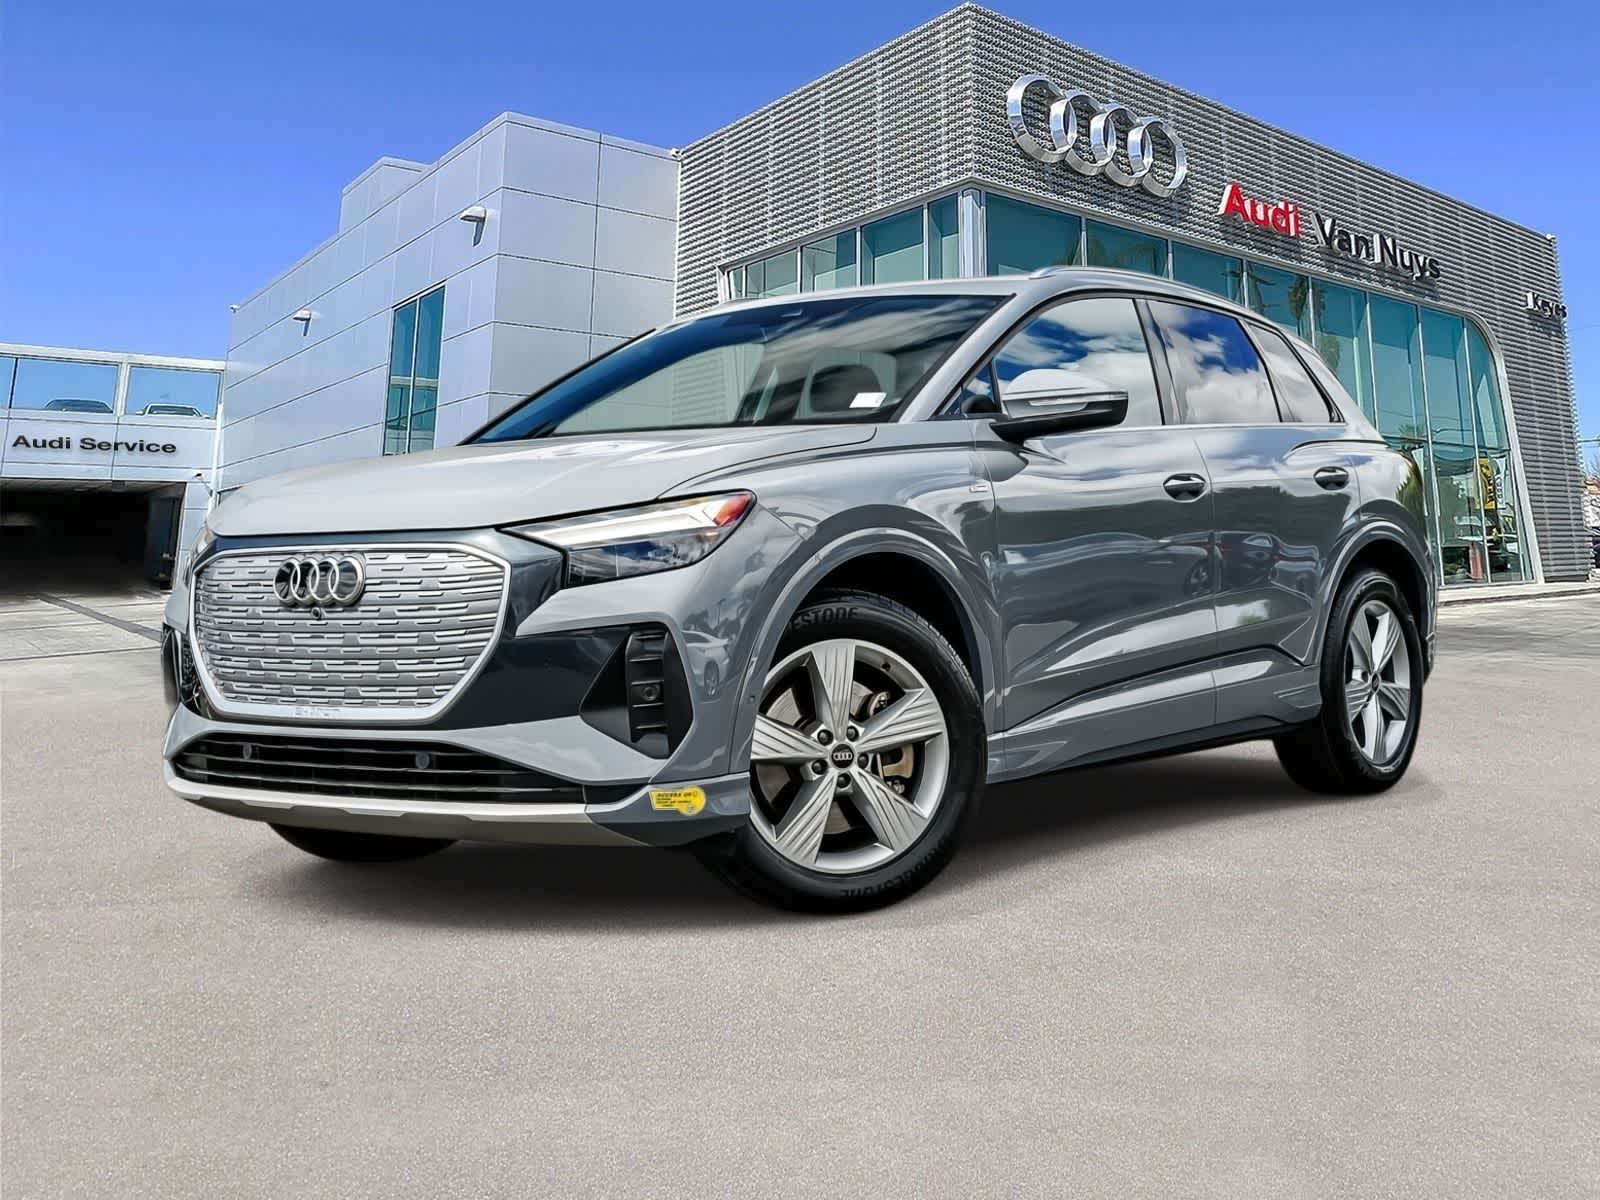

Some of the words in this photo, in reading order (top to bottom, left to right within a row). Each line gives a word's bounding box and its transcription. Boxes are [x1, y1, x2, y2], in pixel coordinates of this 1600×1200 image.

[1217, 182, 1300, 239] Audi
[1310, 212, 1372, 261] Van
[1373, 232, 1441, 280] Nuys
[12, 434, 71, 449] Audi
[79, 437, 177, 454] Service
